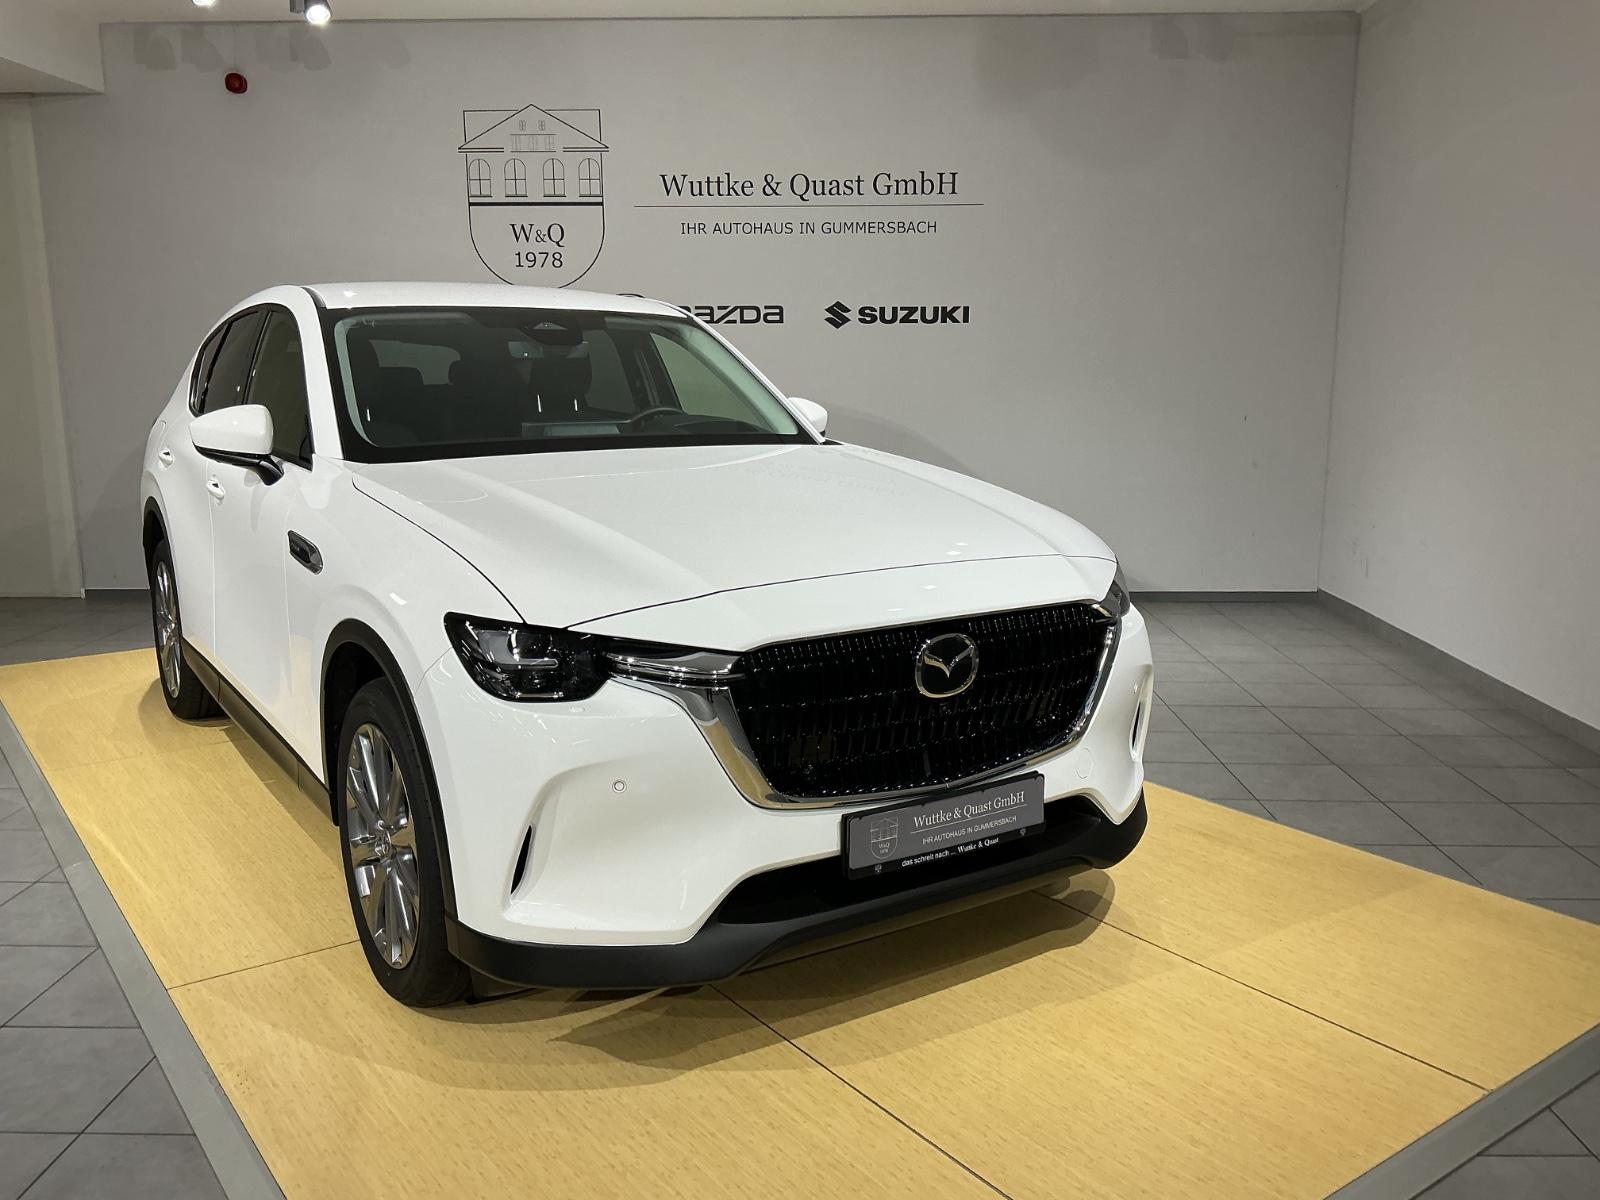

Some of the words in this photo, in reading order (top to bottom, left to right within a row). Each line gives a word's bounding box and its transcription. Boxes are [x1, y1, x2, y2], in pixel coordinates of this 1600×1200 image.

[659, 172, 754, 197] Wuttke
[762, 173, 783, 197] &
[789, 173, 865, 202] Quast
[872, 170, 959, 196] GmbH
[509, 223, 565, 247] W&Q
[680, 222, 708, 235] IHR
[712, 222, 794, 235] AUTOHAUS
[799, 222, 815, 235] IN
[821, 221, 937, 234] GUMMERSBACH
[515, 251, 563, 268] 1978
[858, 305, 970, 324] SUZUKI
[913, 810, 952, 828] Wuttke
[953, 807, 962, 819] &
[963, 800, 992, 817] Quast
[993, 791, 1025, 809] GmbH
[922, 836, 934, 845] IHR
[933, 828, 966, 843] AUTOHAUS
[974, 815, 1017, 832] GUMMERSBACH
[901, 859, 914, 867] das
[934, 849, 950, 859] nach
